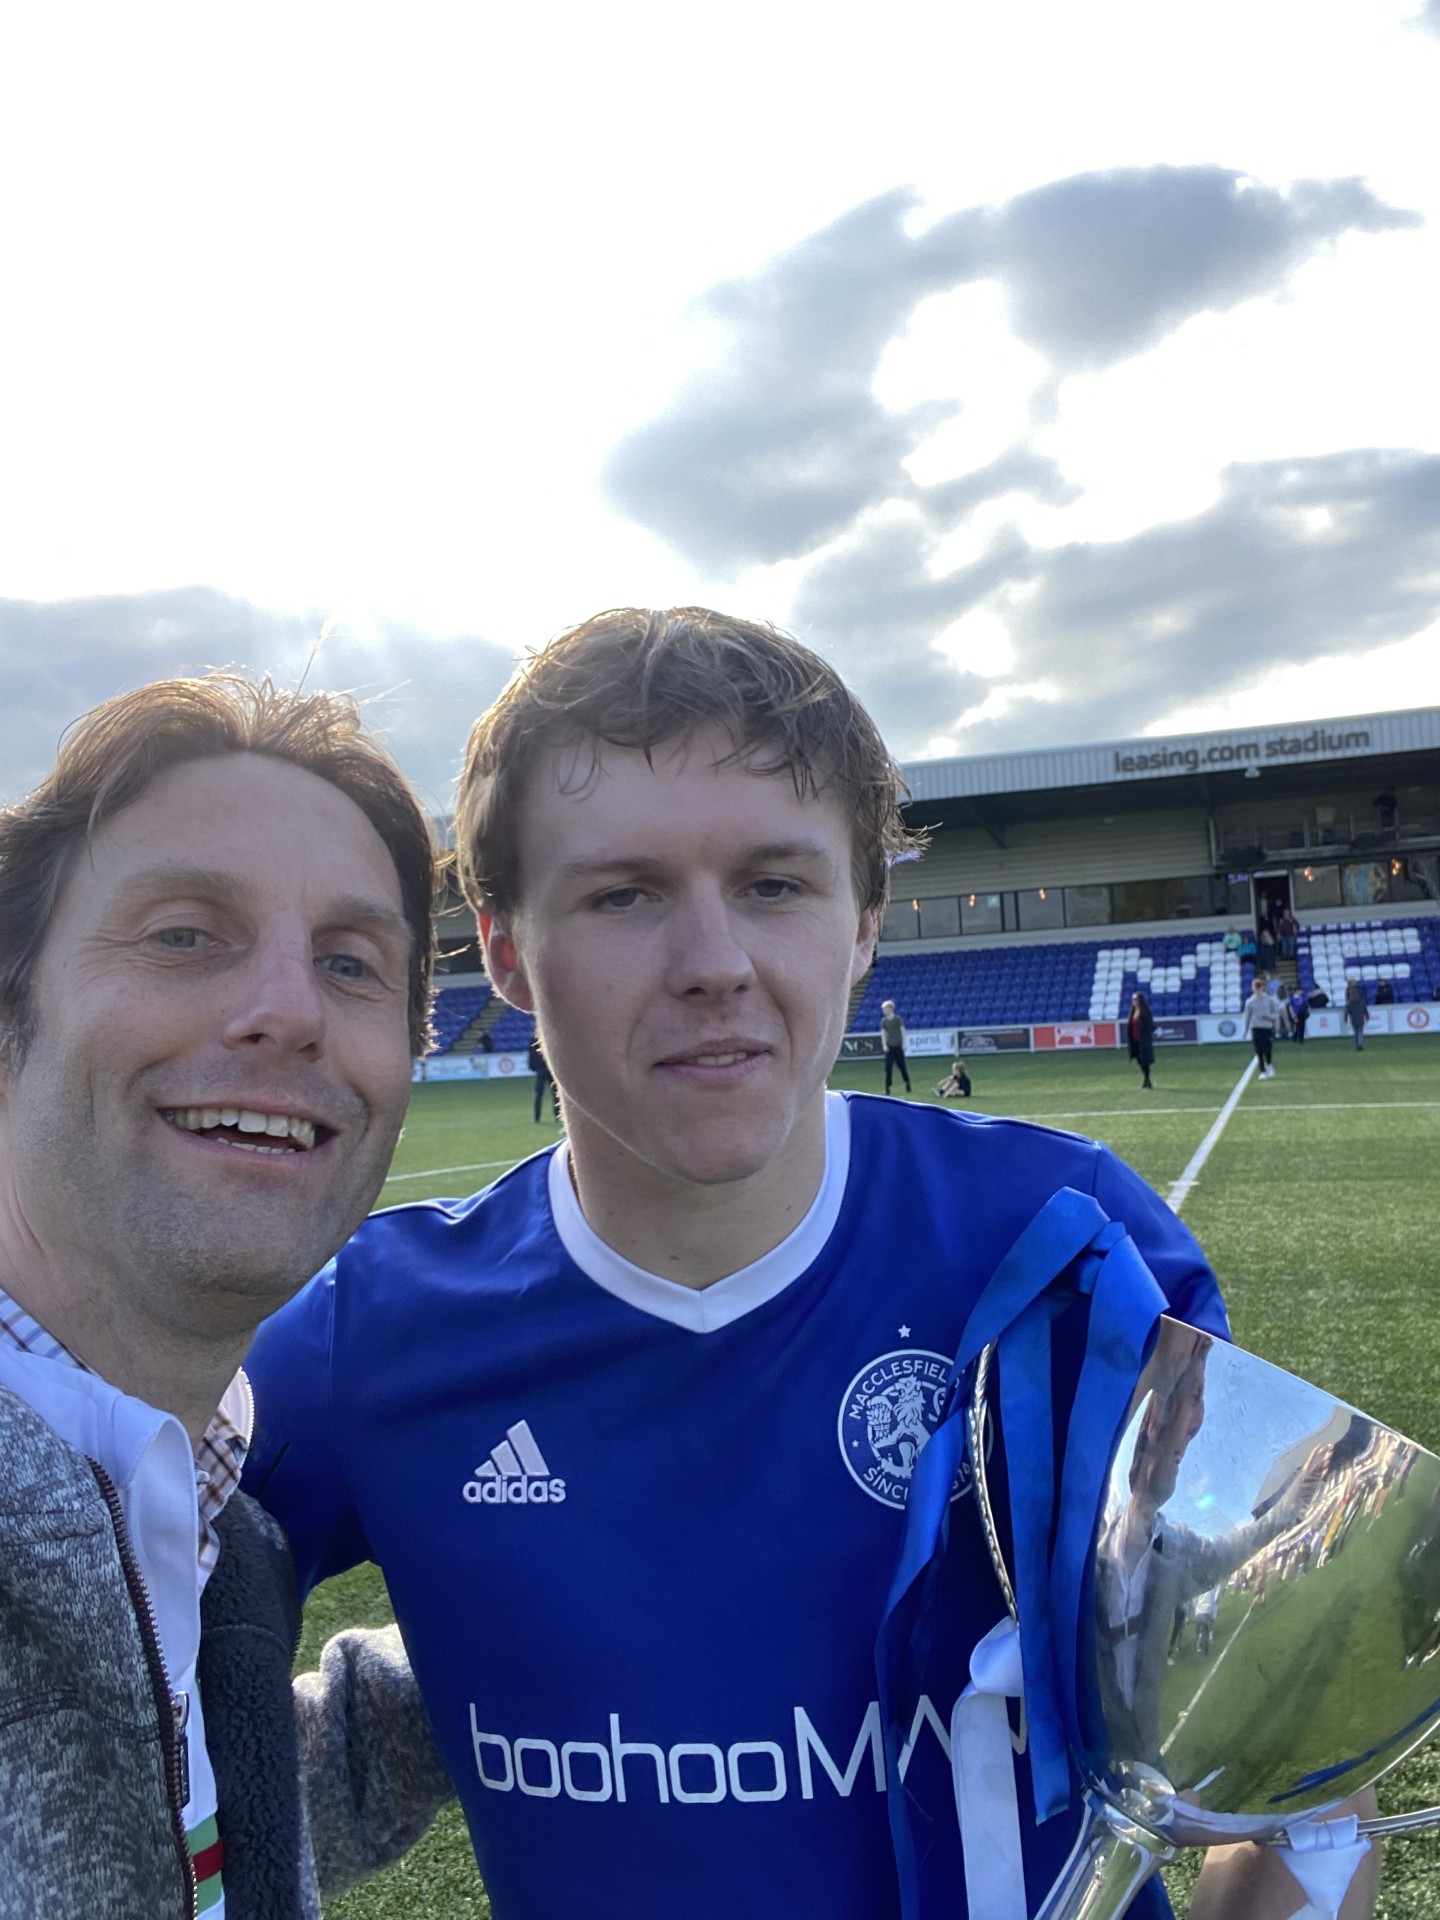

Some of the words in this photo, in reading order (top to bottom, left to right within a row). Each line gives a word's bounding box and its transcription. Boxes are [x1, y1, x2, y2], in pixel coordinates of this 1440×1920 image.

[1114, 741, 1260, 771] leasing.com
[1265, 730, 1371, 758] stadium
[848, 1358, 960, 1420] MACCLESFIEL
[462, 1475, 567, 1504] adidas
